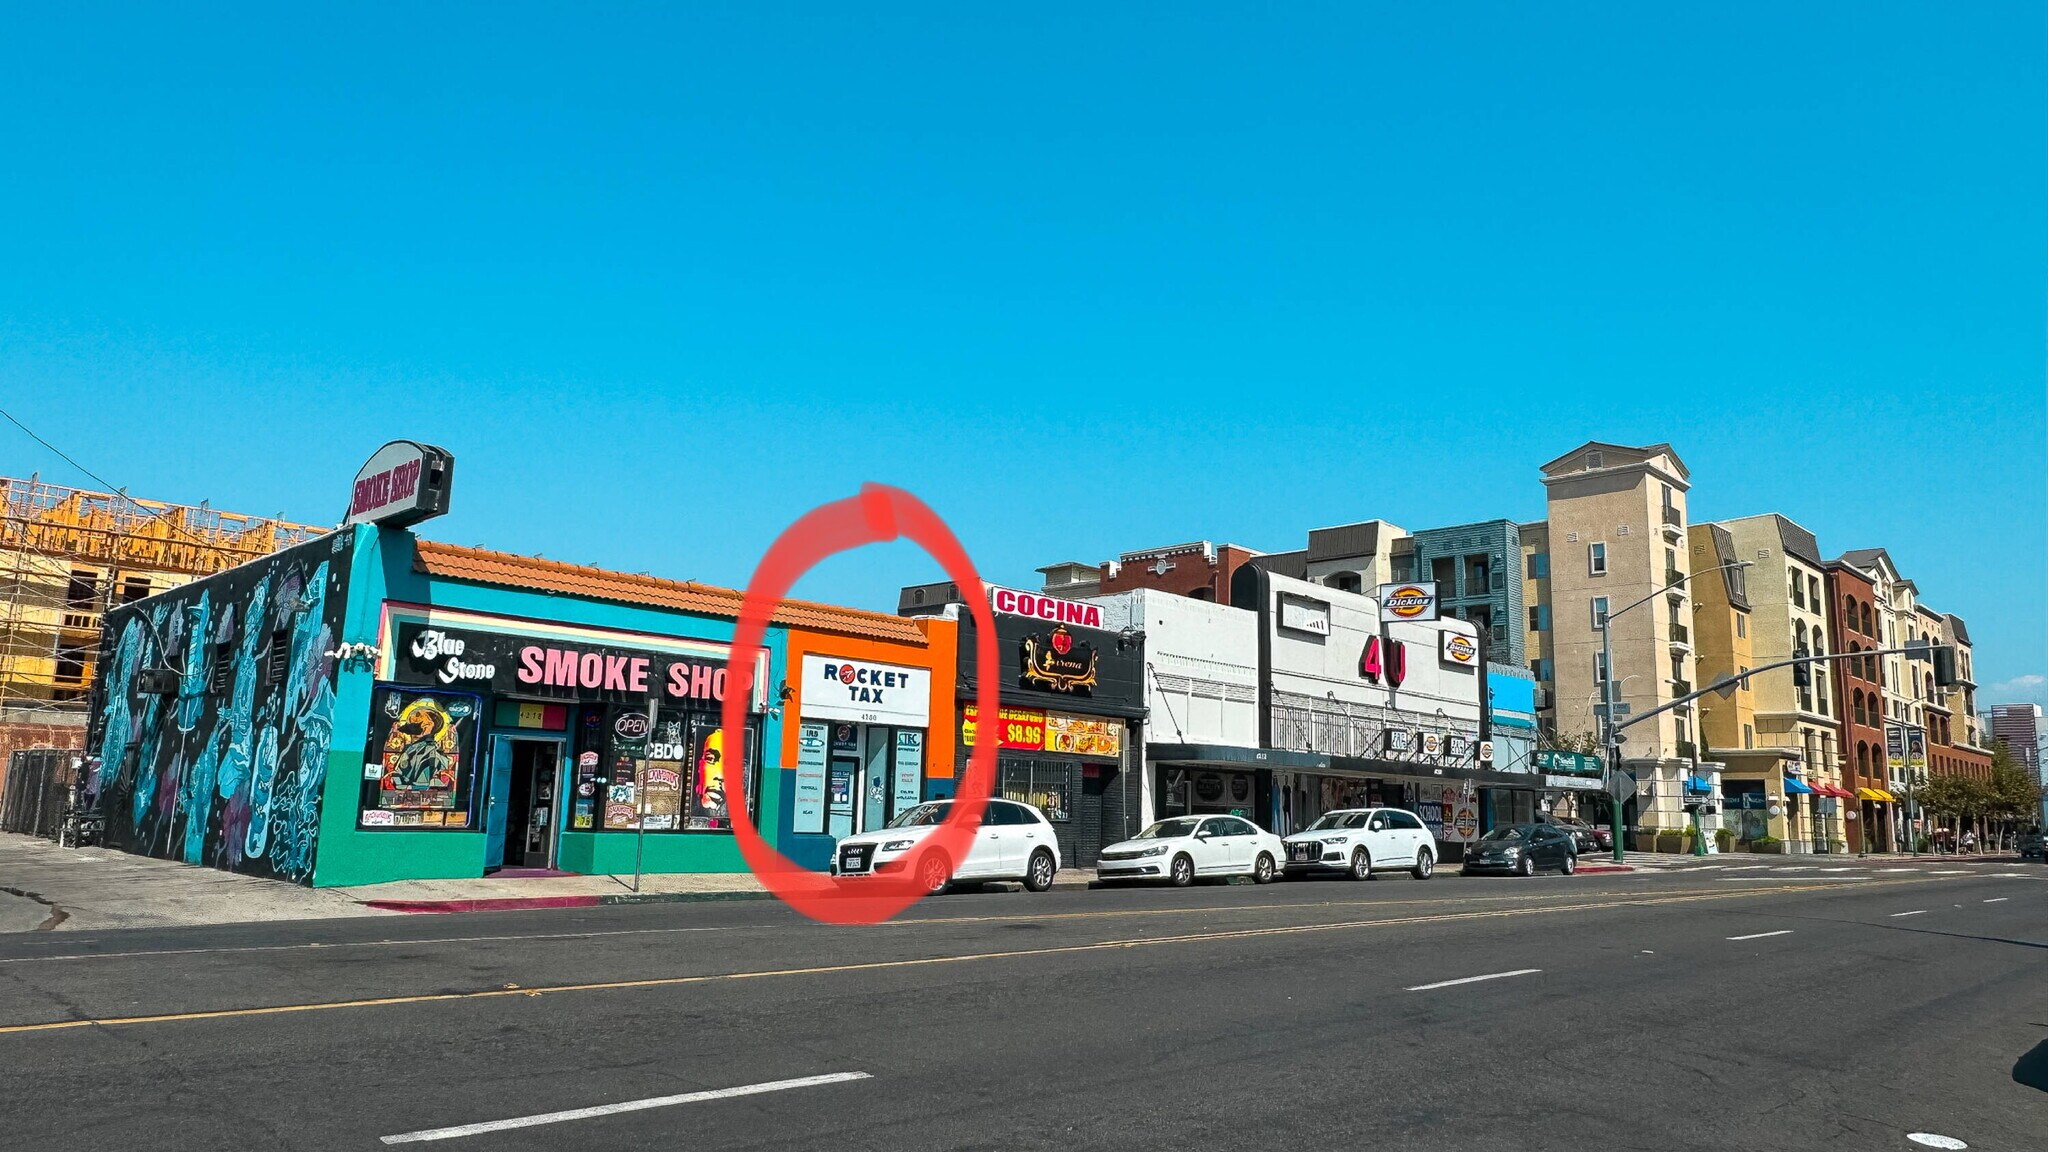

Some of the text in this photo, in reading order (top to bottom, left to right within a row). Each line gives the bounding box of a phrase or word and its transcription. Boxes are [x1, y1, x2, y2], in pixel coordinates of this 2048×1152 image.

[352, 458, 421, 516] SMOKE SHOP
[996, 590, 1100, 627] COCINA
[1386, 597, 1430, 607] Dickies
[412, 630, 465, 660] Blue
[438, 657, 496, 683] Stone
[518, 646, 650, 692] SMOKE
[824, 663, 909, 688] ROCKET
[848, 686, 884, 704] TAX
[617, 719, 650, 732] OPEN
[1007, 723, 1042, 744] $8.99
[1419, 804, 1443, 822] SCHOOL
